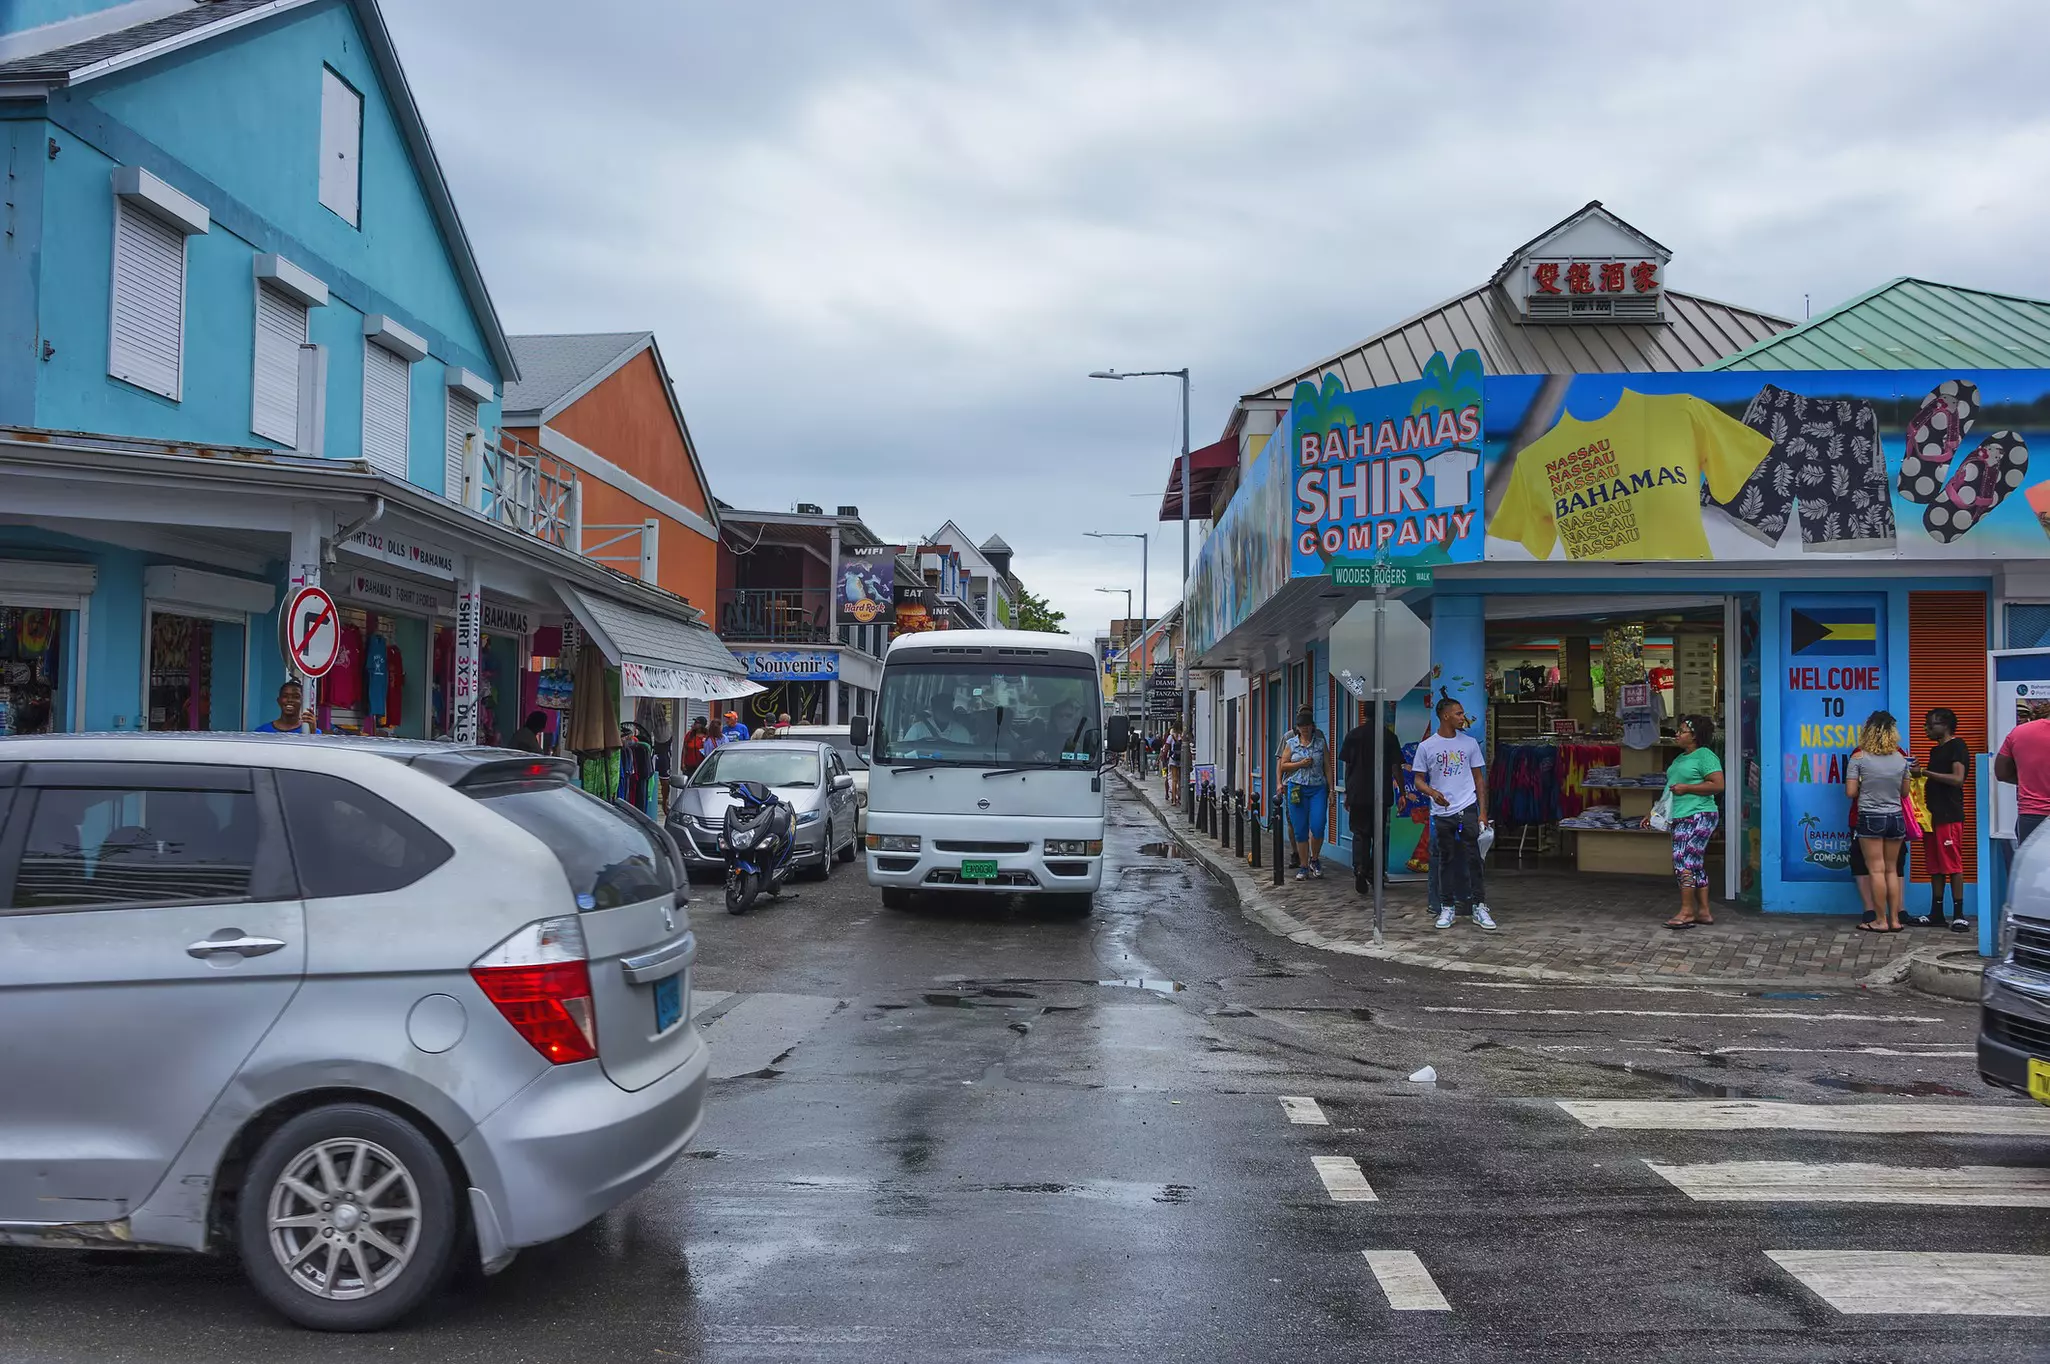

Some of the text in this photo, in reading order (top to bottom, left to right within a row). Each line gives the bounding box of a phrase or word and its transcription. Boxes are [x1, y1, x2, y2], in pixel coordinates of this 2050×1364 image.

[1533, 261, 1659, 294] 雙龍酒家
[1299, 405, 1480, 466] BAHAMAS
[1545, 438, 1611, 474] NASSAU
[1548, 451, 1616, 487] NASSAU
[1552, 464, 1620, 499] NASSAU
[1555, 466, 1687, 519] BAHAMAS
[1558, 499, 1633, 534] NASSAU
[1564, 514, 1637, 547] NASSAU
[1298, 510, 1476, 555] COMPANY
[1570, 528, 1641, 560] NASSAU
[367, 533, 383, 550] 3X2
[387, 540, 406, 557] DLLS
[420, 550, 452, 572] BAHAMAS
[854, 547, 883, 556] WIFI
[365, 579, 391, 598] BAHAMAS
[1335, 568, 1431, 584] WOODES ROGERS WALK
[844, 599, 886, 613] Hard Rock
[903, 589, 923, 598] EAT
[484, 607, 528, 633] BAHAMAS
[457, 593, 471, 742] TSHIRT 3X25 DLLS
[755, 655, 834, 673] Souvenir's
[1789, 667, 1880, 690] WELCOME
[1822, 698, 1844, 717] TO
[1800, 724, 1862, 748] NASSA
[1436, 750, 1465, 767] CHASE
[1813, 853, 1852, 863] COMPAN
